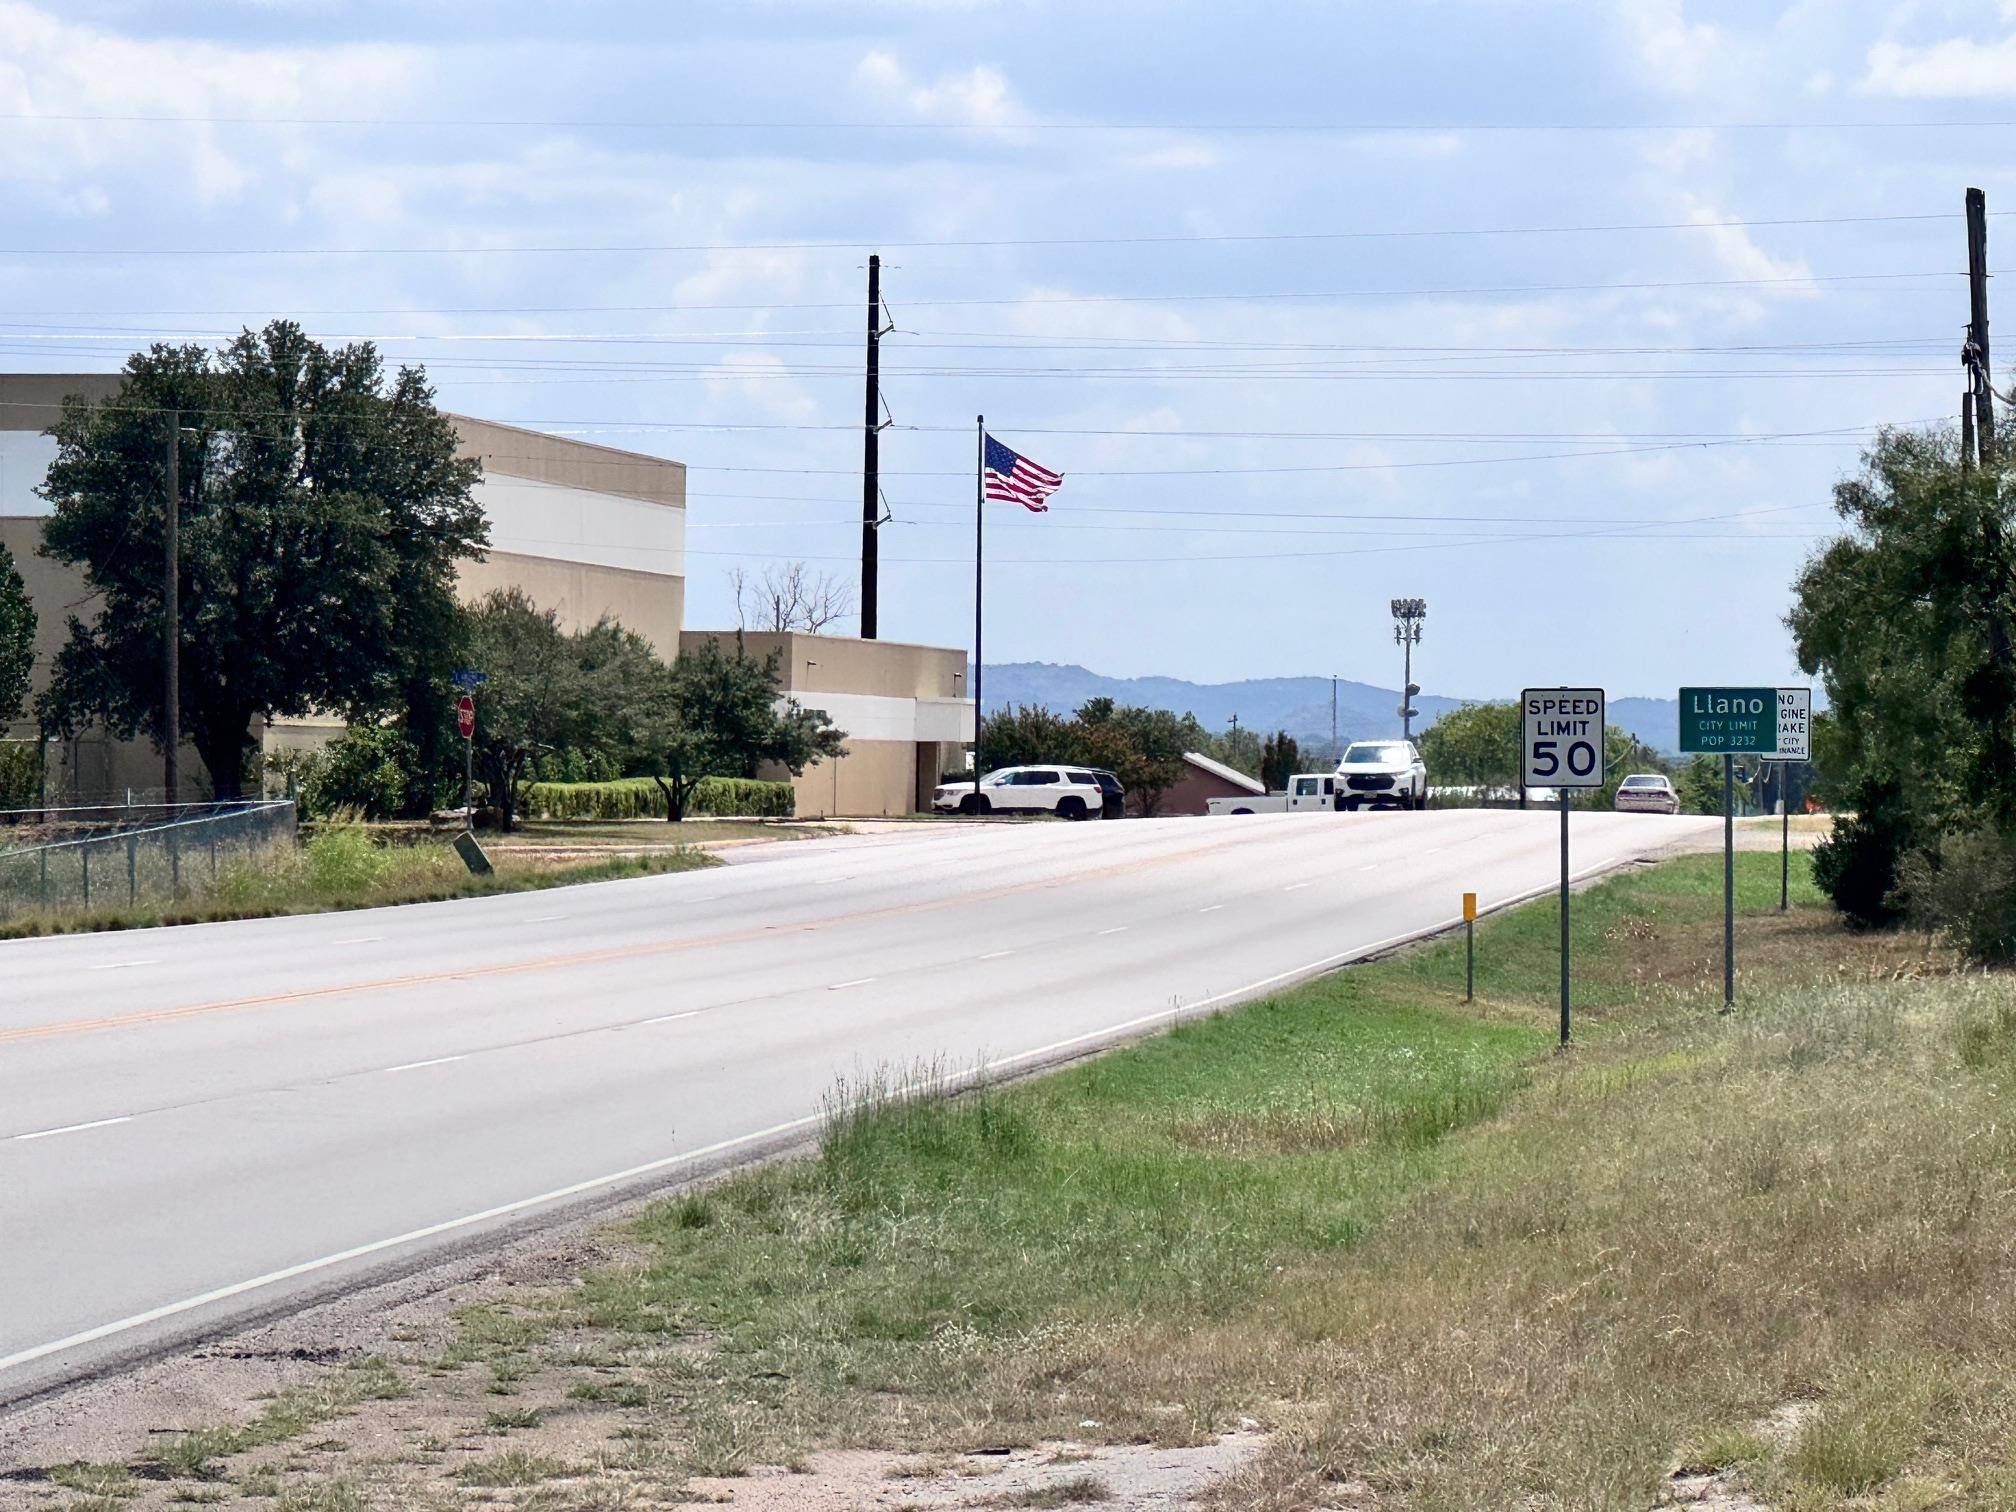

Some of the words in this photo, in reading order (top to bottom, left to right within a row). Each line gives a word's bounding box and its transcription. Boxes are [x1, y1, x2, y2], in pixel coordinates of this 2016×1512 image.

[1529, 699, 1599, 715] SPEED
[1694, 694, 1764, 714] Llano
[1780, 709, 1806, 719] GINE
[1537, 720, 1590, 736] LIMIT
[1699, 720, 1723, 731] CITY
[1729, 720, 1758, 731] LIMIT
[1778, 722, 1805, 734] AKE
[1701, 736, 1725, 746] POP
[1730, 736, 1756, 746] 3232
[1783, 737, 1800, 745] CITY
[1779, 747, 1806, 755] INANCE
[1532, 741, 1596, 776] 50
